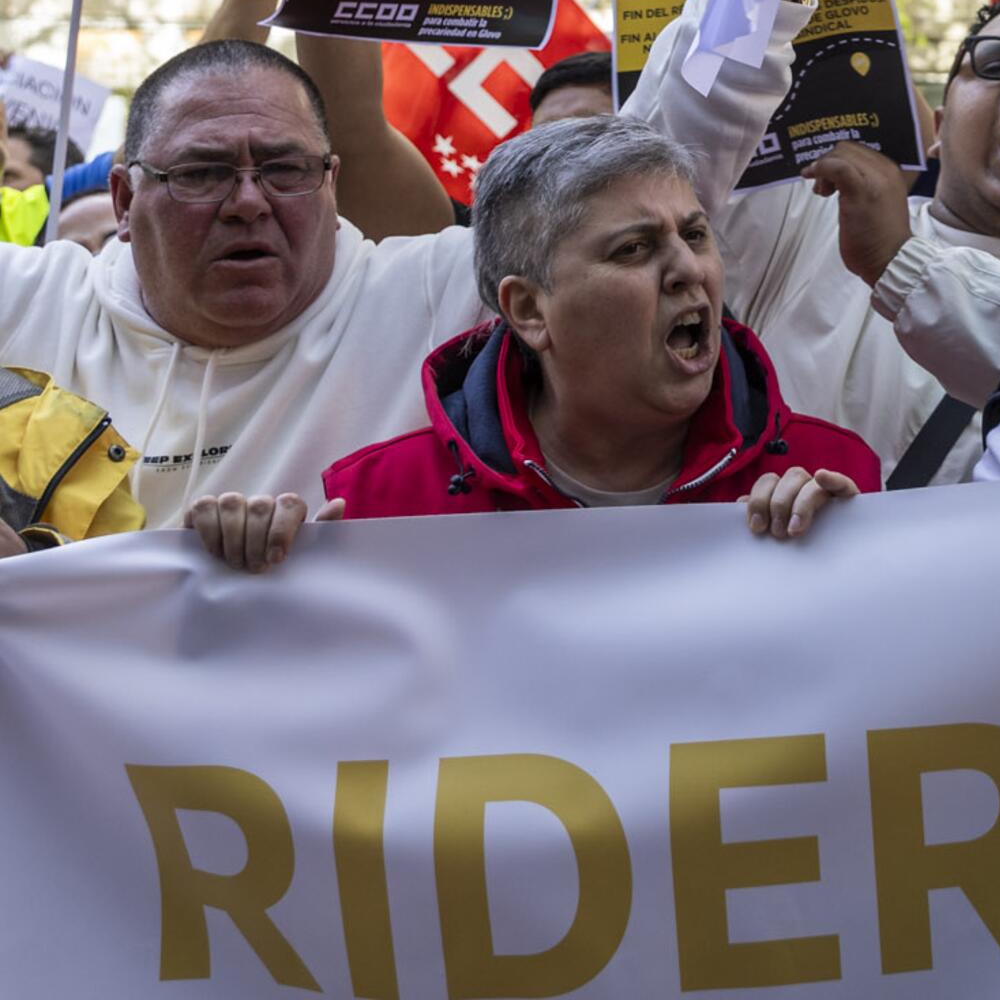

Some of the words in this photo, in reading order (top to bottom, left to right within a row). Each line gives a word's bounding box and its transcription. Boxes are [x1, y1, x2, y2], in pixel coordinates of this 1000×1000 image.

[333, 0, 420, 21] CCOO
[622, 8, 643, 20] FIN
[646, 6, 669, 19] DEL
[826, 5, 869, 20] GLOVO
[620, 32, 641, 44] FIN
